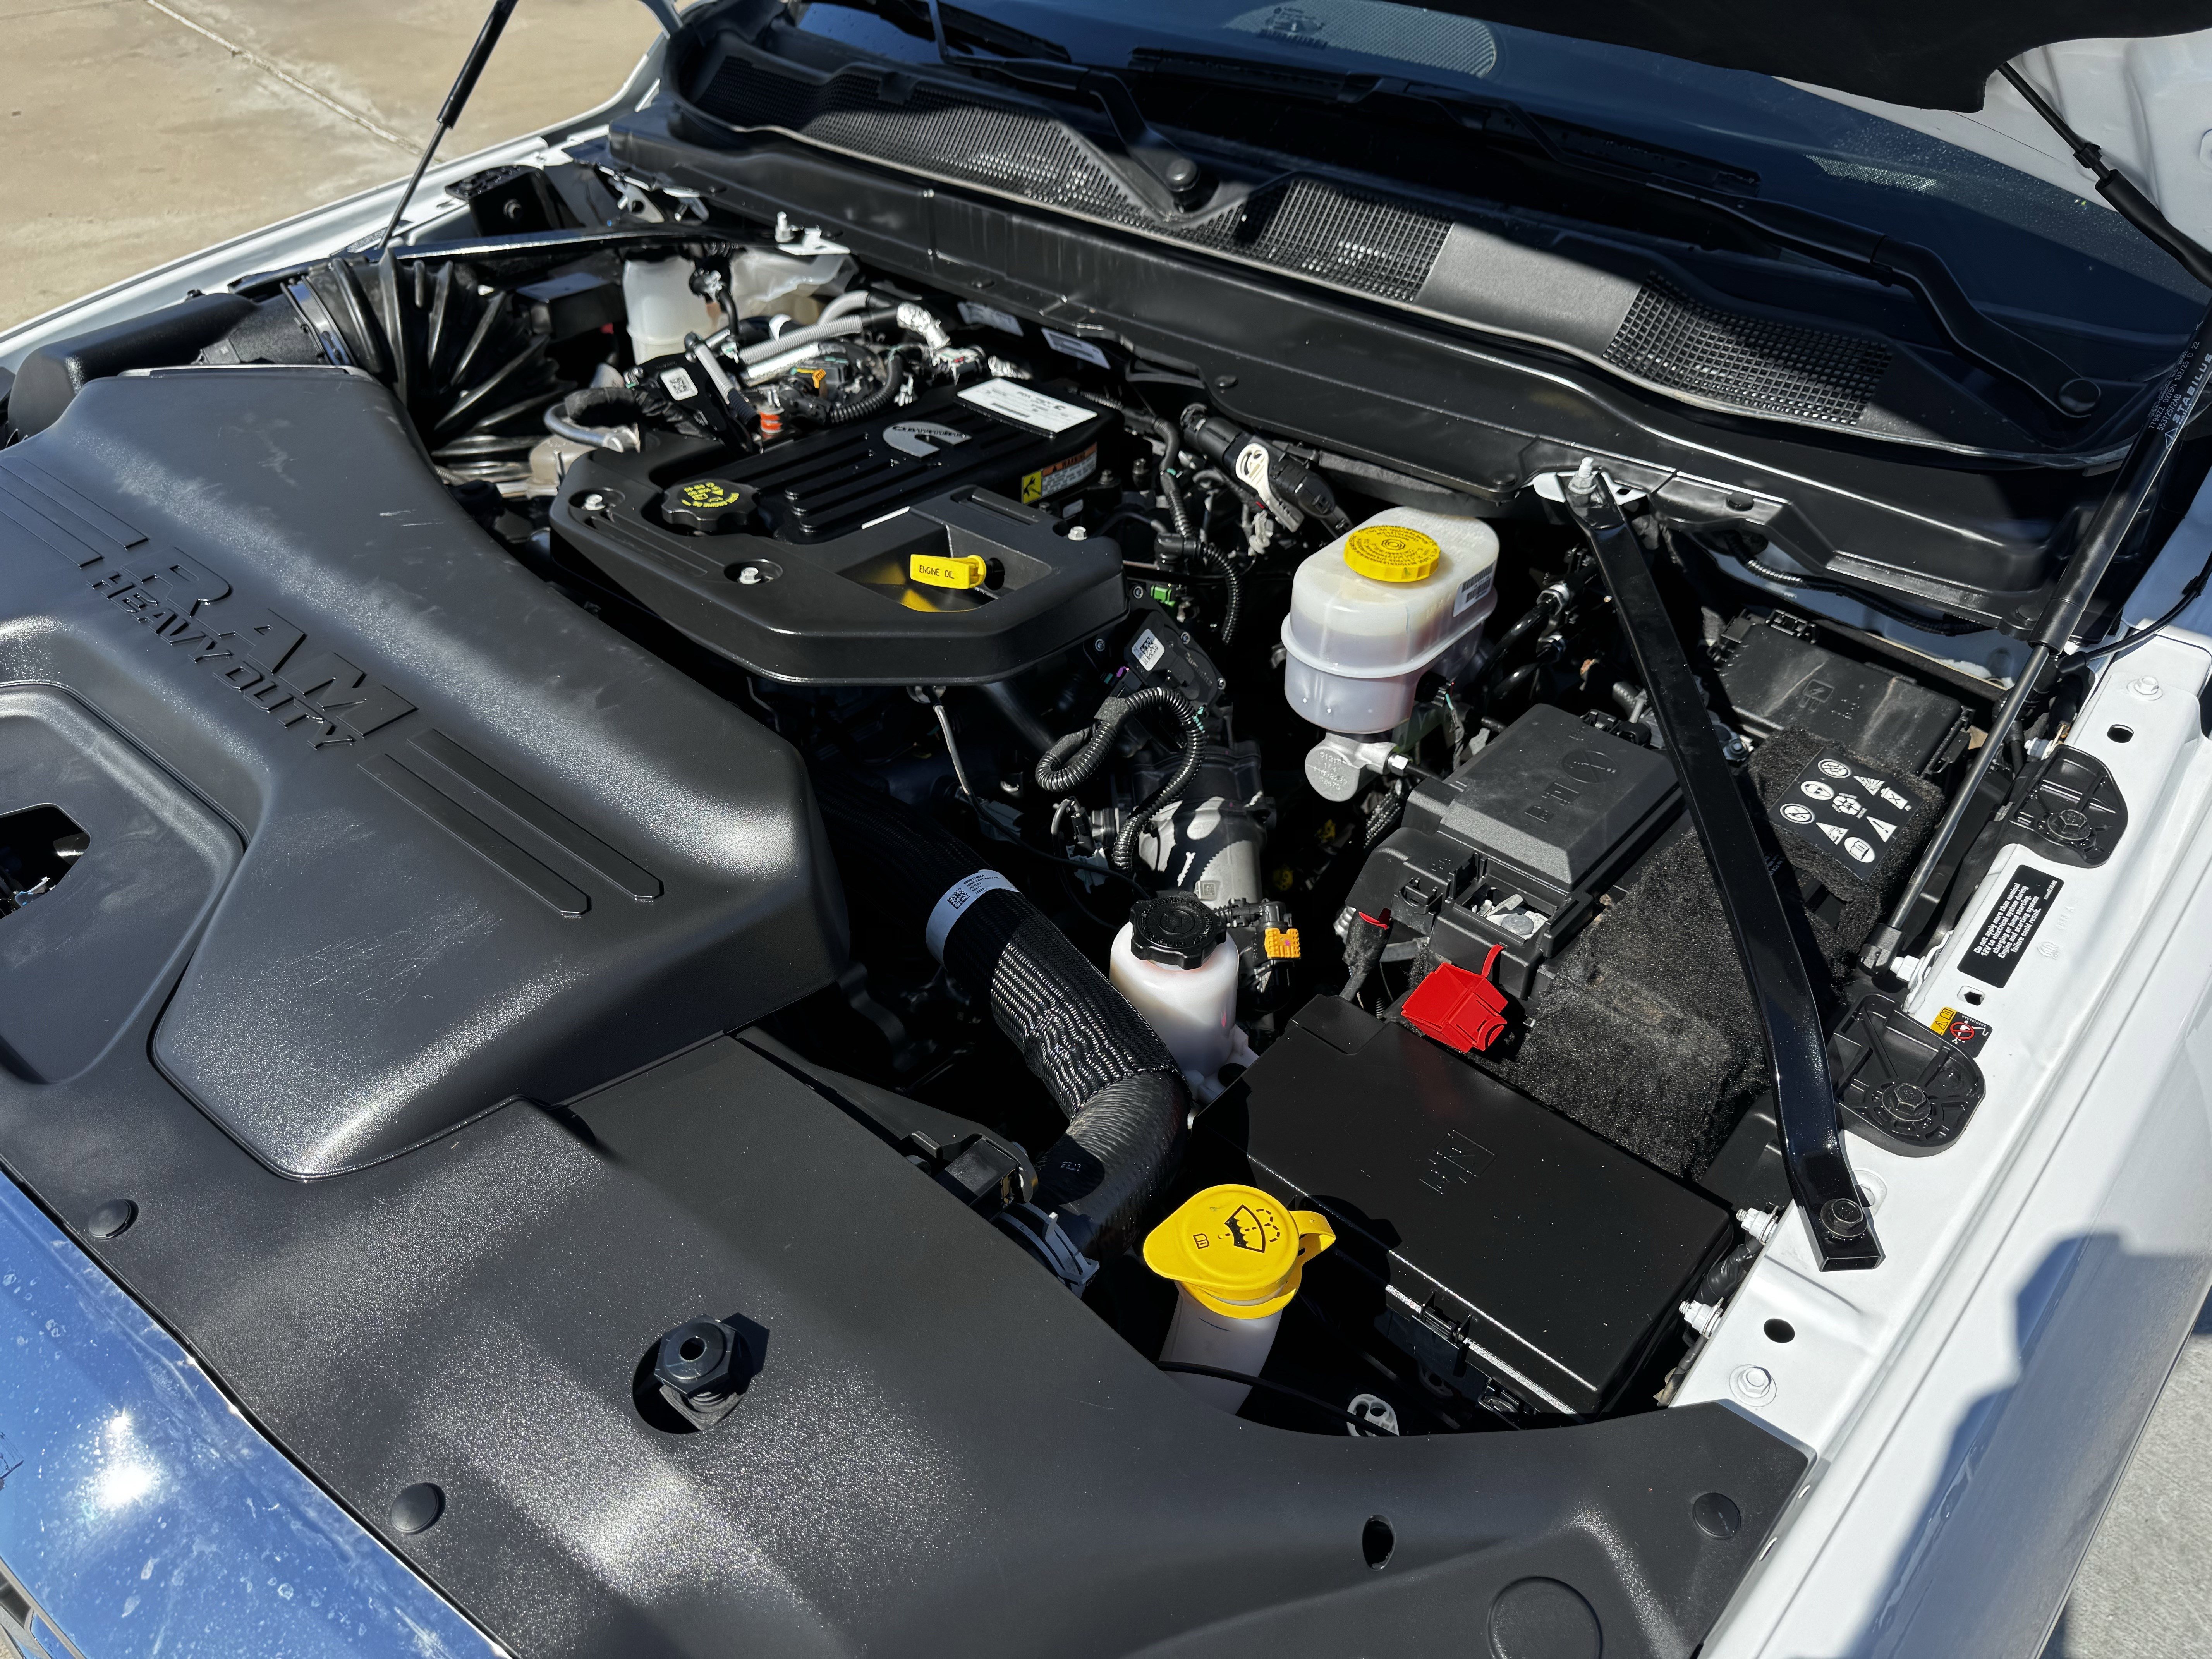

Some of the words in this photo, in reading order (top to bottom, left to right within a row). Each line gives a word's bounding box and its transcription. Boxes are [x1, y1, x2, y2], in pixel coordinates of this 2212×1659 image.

[2162, 384, 2177, 403] 0275N
[2174, 361, 2189, 380] 132/25
[2171, 353, 2212, 423] STABILUS
[919, 565, 940, 576] ENGINE
[945, 570, 955, 579] OIL
[86, 570, 232, 663] HEAVY
[212, 661, 355, 750] DUTY
[121, 546, 418, 737] RAM
[1973, 946, 1983, 954] Do
[1979, 936, 1988, 946] not
[1985, 924, 1997, 937] apply
[1992, 912, 2003, 924] more
[1999, 900, 2010, 912] than
[2007, 883, 2021, 901] nominal
[1981, 945, 1992, 956] 12V
[1992, 916, 2009, 940] electrical
[2006, 900, 2019, 917] system
[2014, 885, 2029, 902] during
[1993, 933, 2010, 956] charging
[2007, 913, 2020, 928] jump
[2016, 895, 2032, 915] starting.
[1997, 941, 2014, 958] Engine
[2008, 931, 2018, 942] and
[2014, 913, 2031, 933] starting
[2026, 896, 2039, 913] system
[2010, 936, 2025, 953] failure
[2021, 922, 2032, 937] could
[2028, 908, 2042, 924] result.
